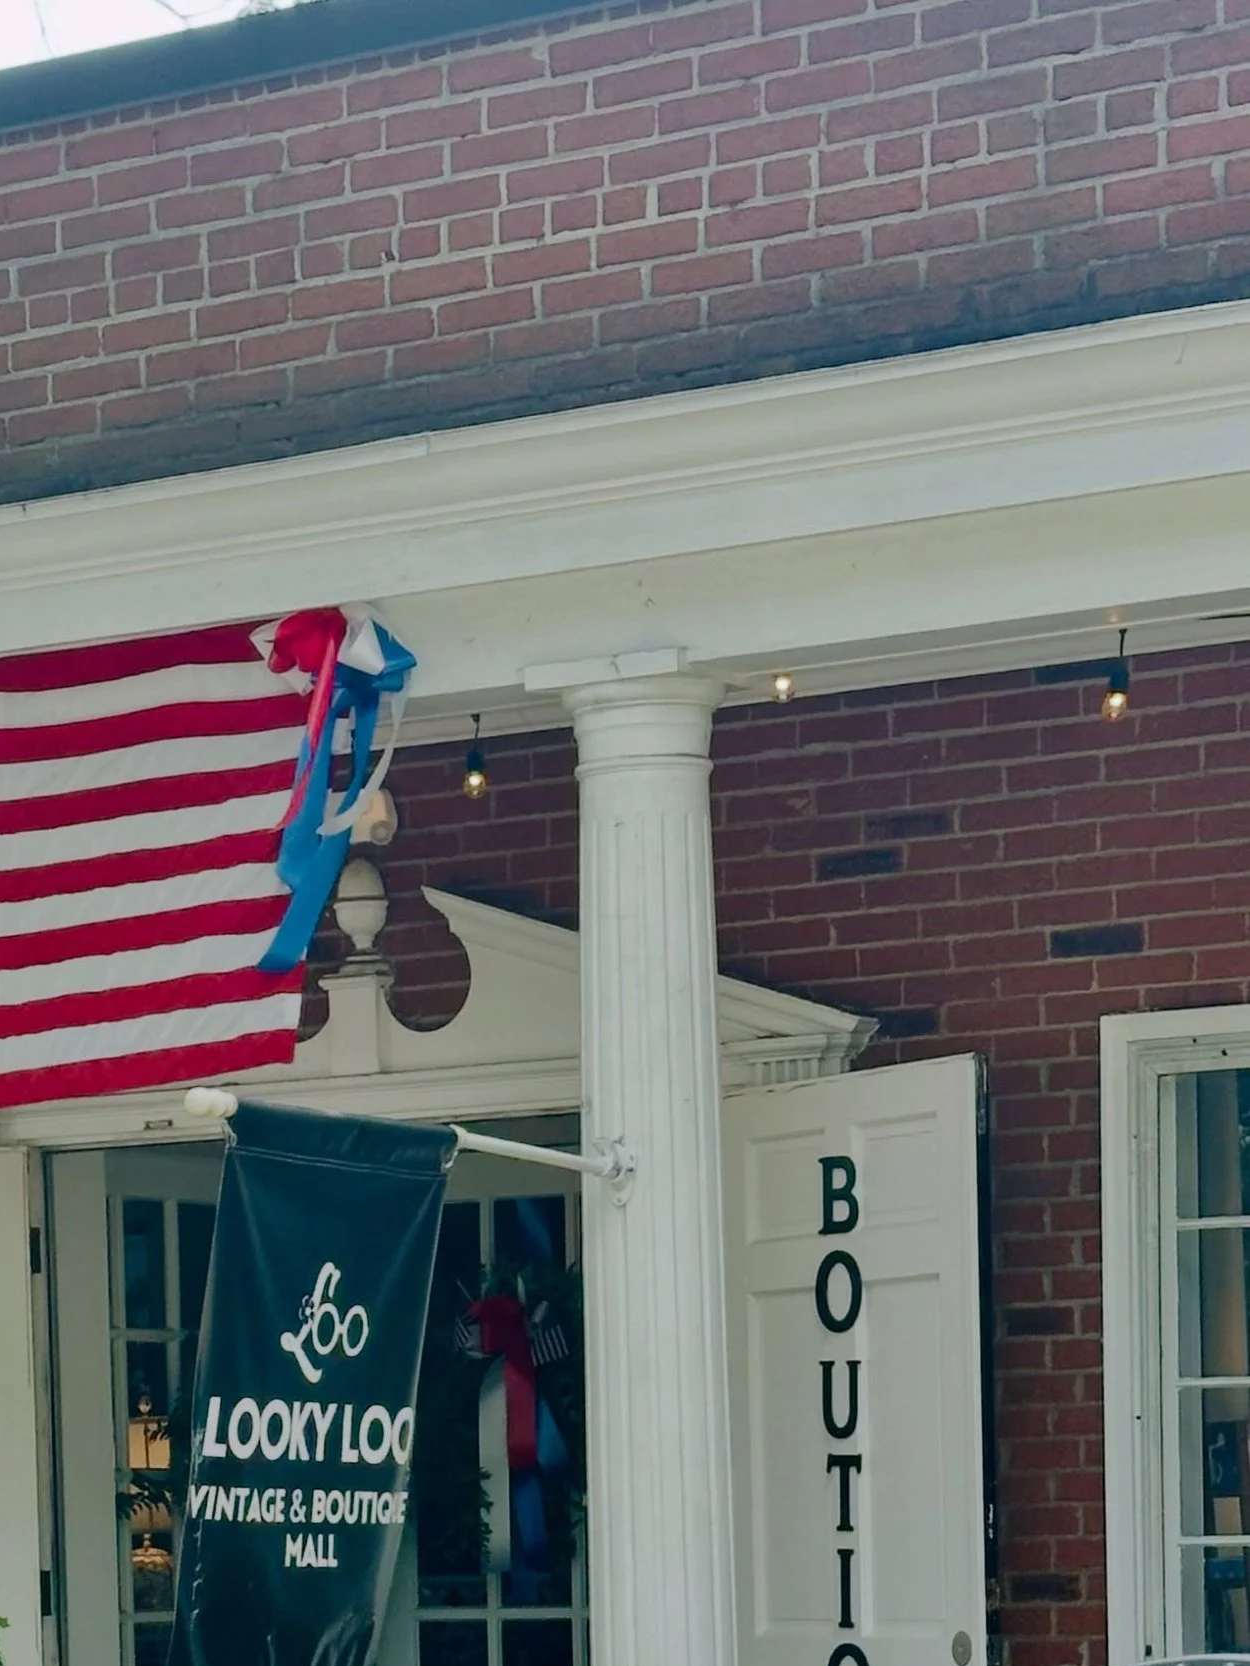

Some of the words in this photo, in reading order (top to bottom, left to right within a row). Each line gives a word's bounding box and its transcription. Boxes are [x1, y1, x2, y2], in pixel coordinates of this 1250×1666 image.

[202, 1396, 338, 1461] LOOKY
[189, 1485, 287, 1523] VINTAGE
[289, 1489, 307, 1523] &
[284, 1533, 339, 1568] MALL
